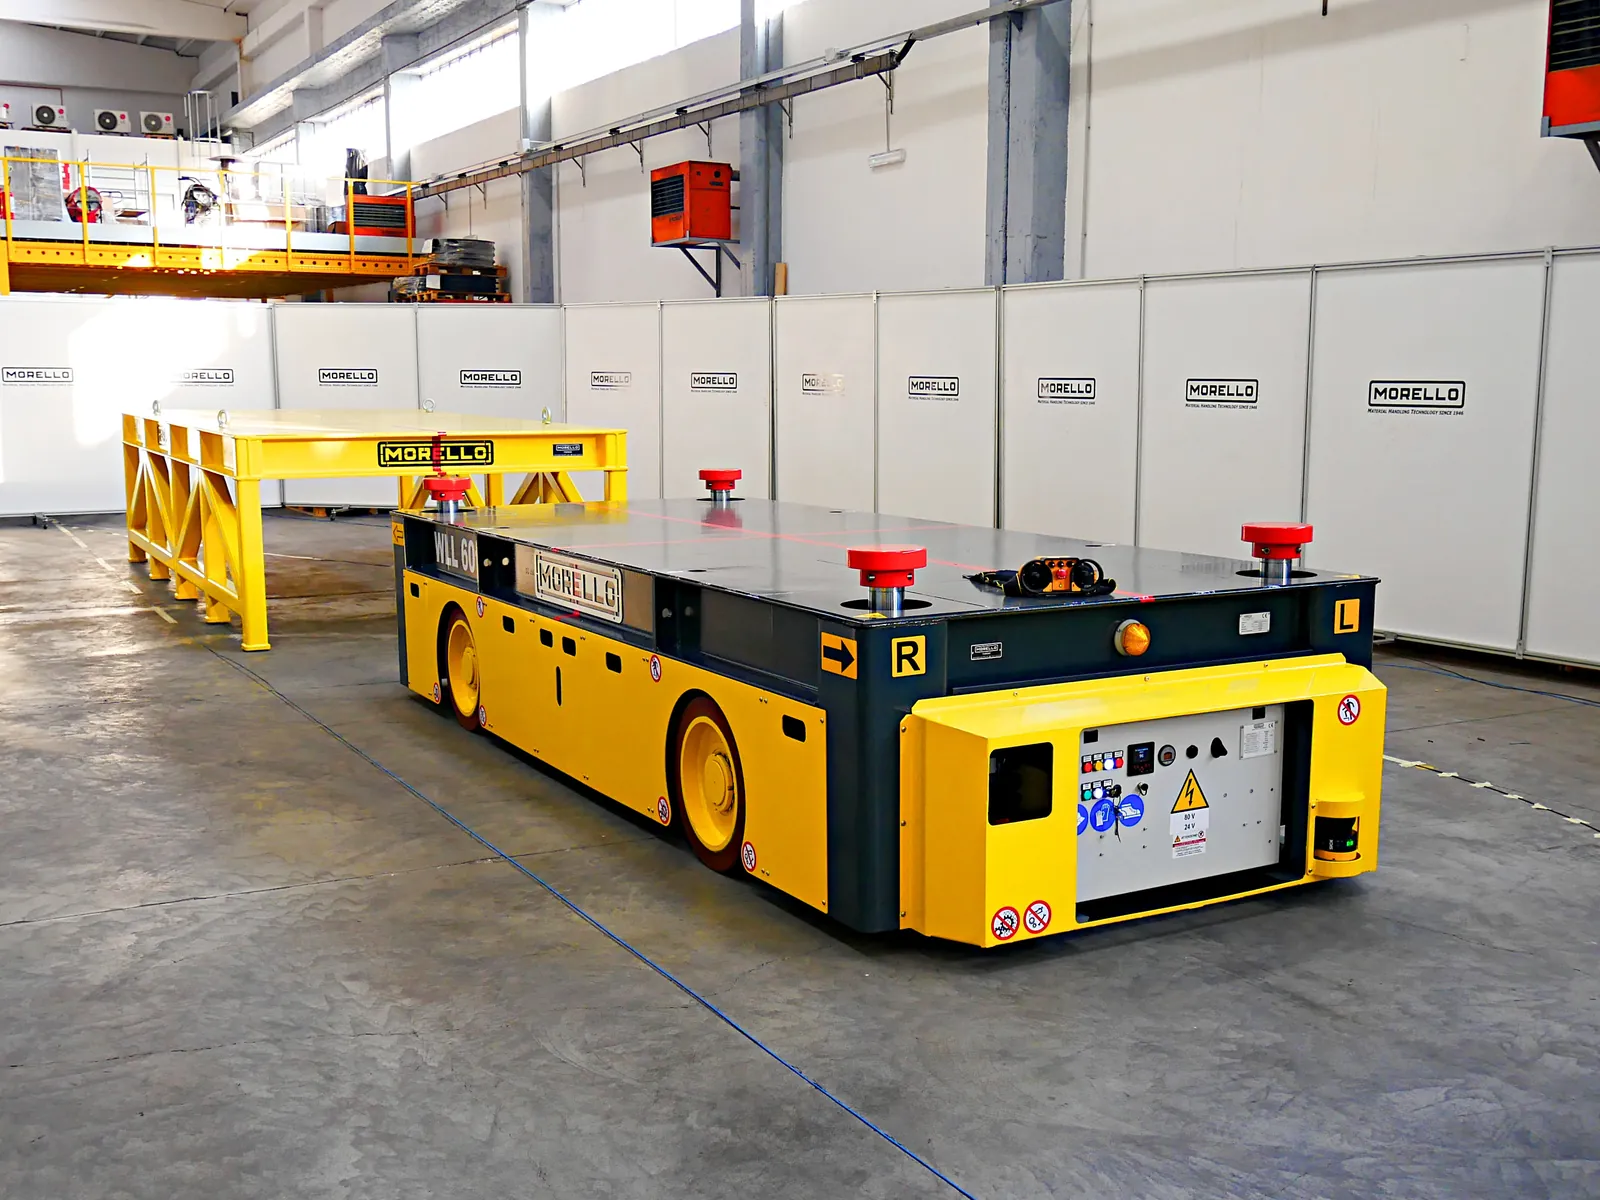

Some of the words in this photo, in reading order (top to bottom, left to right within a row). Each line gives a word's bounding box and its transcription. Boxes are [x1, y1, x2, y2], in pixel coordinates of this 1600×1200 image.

[6, 371, 70, 379] MORELLO
[182, 372, 230, 380] ORELLO
[322, 372, 374, 380] MORELLO
[463, 373, 518, 381] MORELLO
[593, 375, 629, 383] MORELLO
[693, 376, 735, 385] MORELLO
[911, 381, 956, 391] MORELLO
[1040, 383, 1092, 394] MORELLO
[1189, 384, 1254, 397] MORELLO
[1373, 387, 1459, 401] MORELLO
[385, 447, 487, 461] MORELLO
[434, 531, 458, 568] WLL
[461, 537, 475, 573] 60
[539, 562, 615, 607] MORELLO
[1340, 603, 1354, 630] L
[897, 641, 920, 673] R
